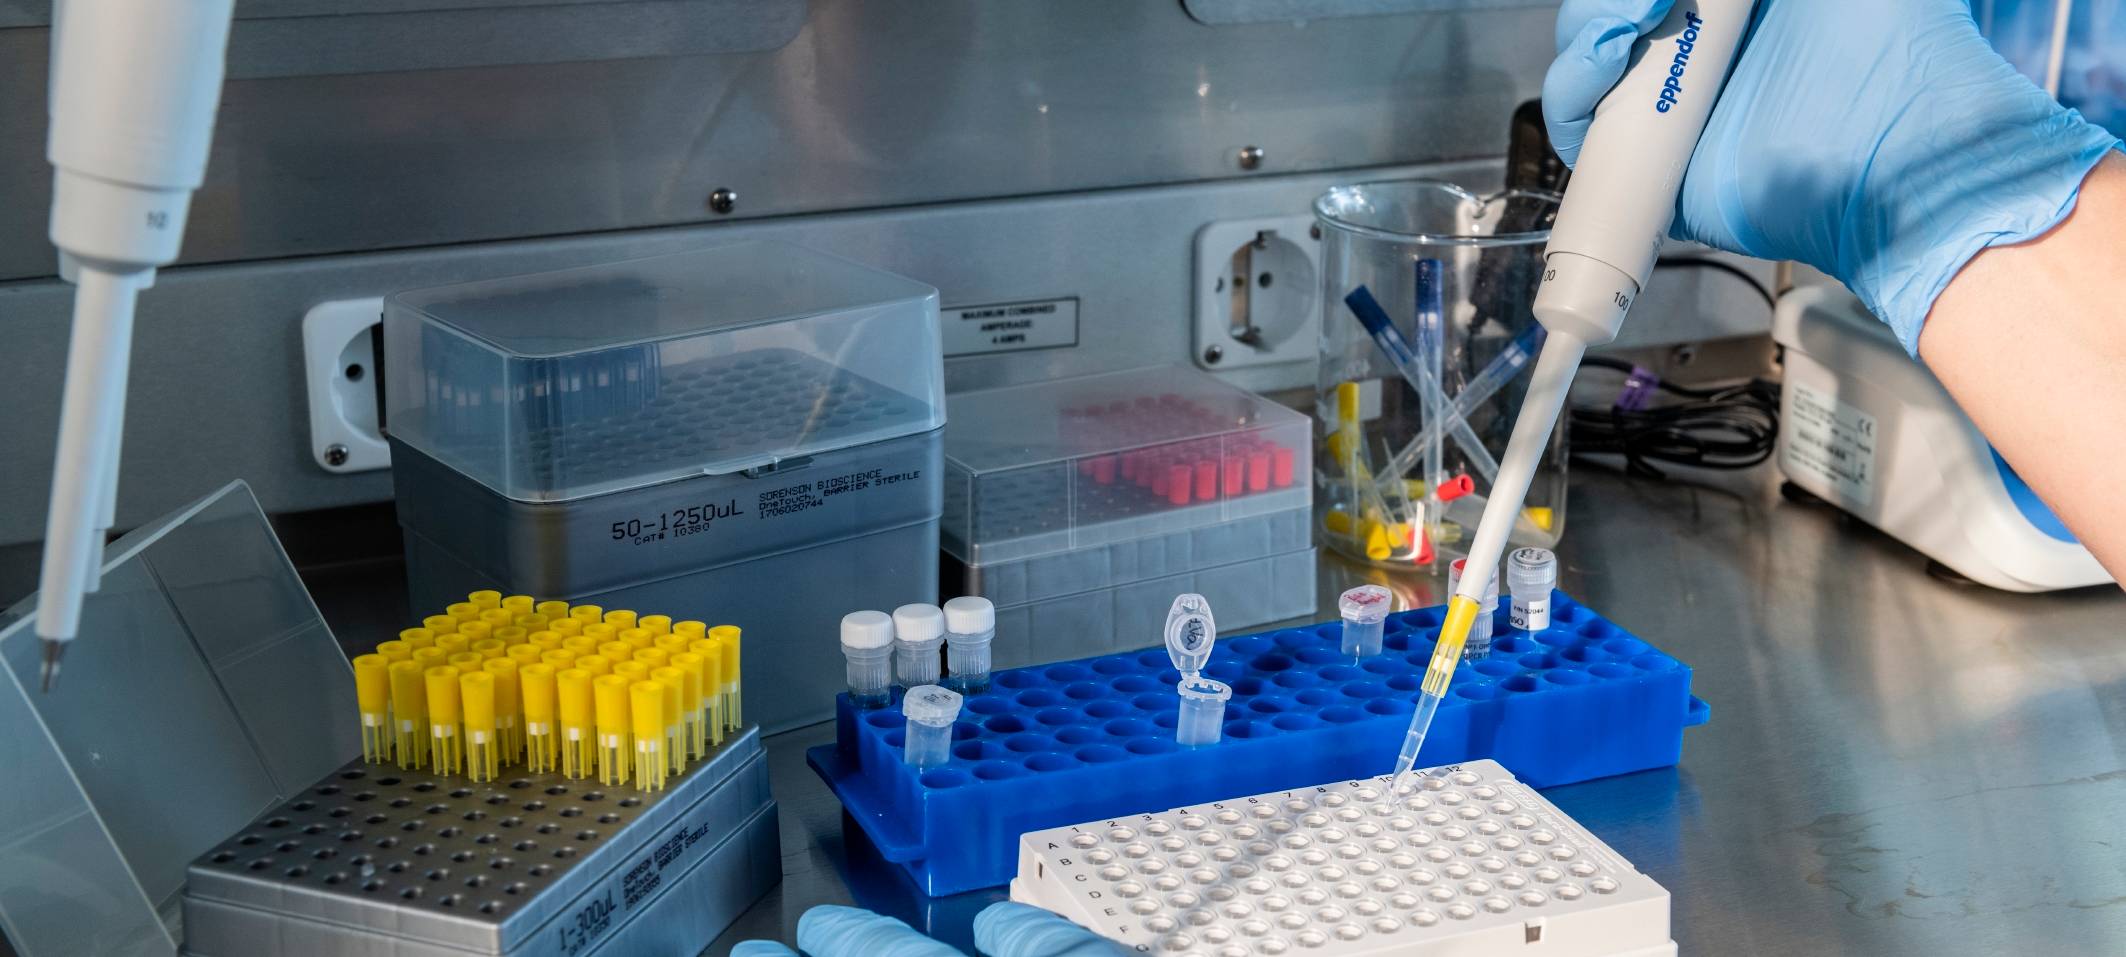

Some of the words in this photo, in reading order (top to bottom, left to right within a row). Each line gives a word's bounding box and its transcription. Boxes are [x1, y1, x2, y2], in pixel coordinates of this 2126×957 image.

[1656, 11, 1702, 113] eppendorf
[1543, 269, 1555, 281] 00
[1614, 291, 1629, 311] 100
[759, 483, 812, 502] SORENSON
[817, 468, 882, 490] BIOSCIENCE
[823, 482, 869, 497] BARRIER
[875, 470, 920, 486] STERILE
[612, 499, 744, 540] 50-1250uL
[759, 499, 823, 520] 1706020744
[634, 532, 665, 546] CAT#
[673, 522, 710, 538] 10380
[1107, 820, 1118, 828] 2
[1445, 765, 1462, 773] 12
[1048, 841, 1059, 850] A
[1060, 858, 1072, 866] B
[1075, 873, 1087, 882] C
[1089, 890, 1102, 899] D
[559, 889, 617, 951] 1-300uL
[1104, 907, 1117, 917] E
[1119, 925, 1129, 934] F
